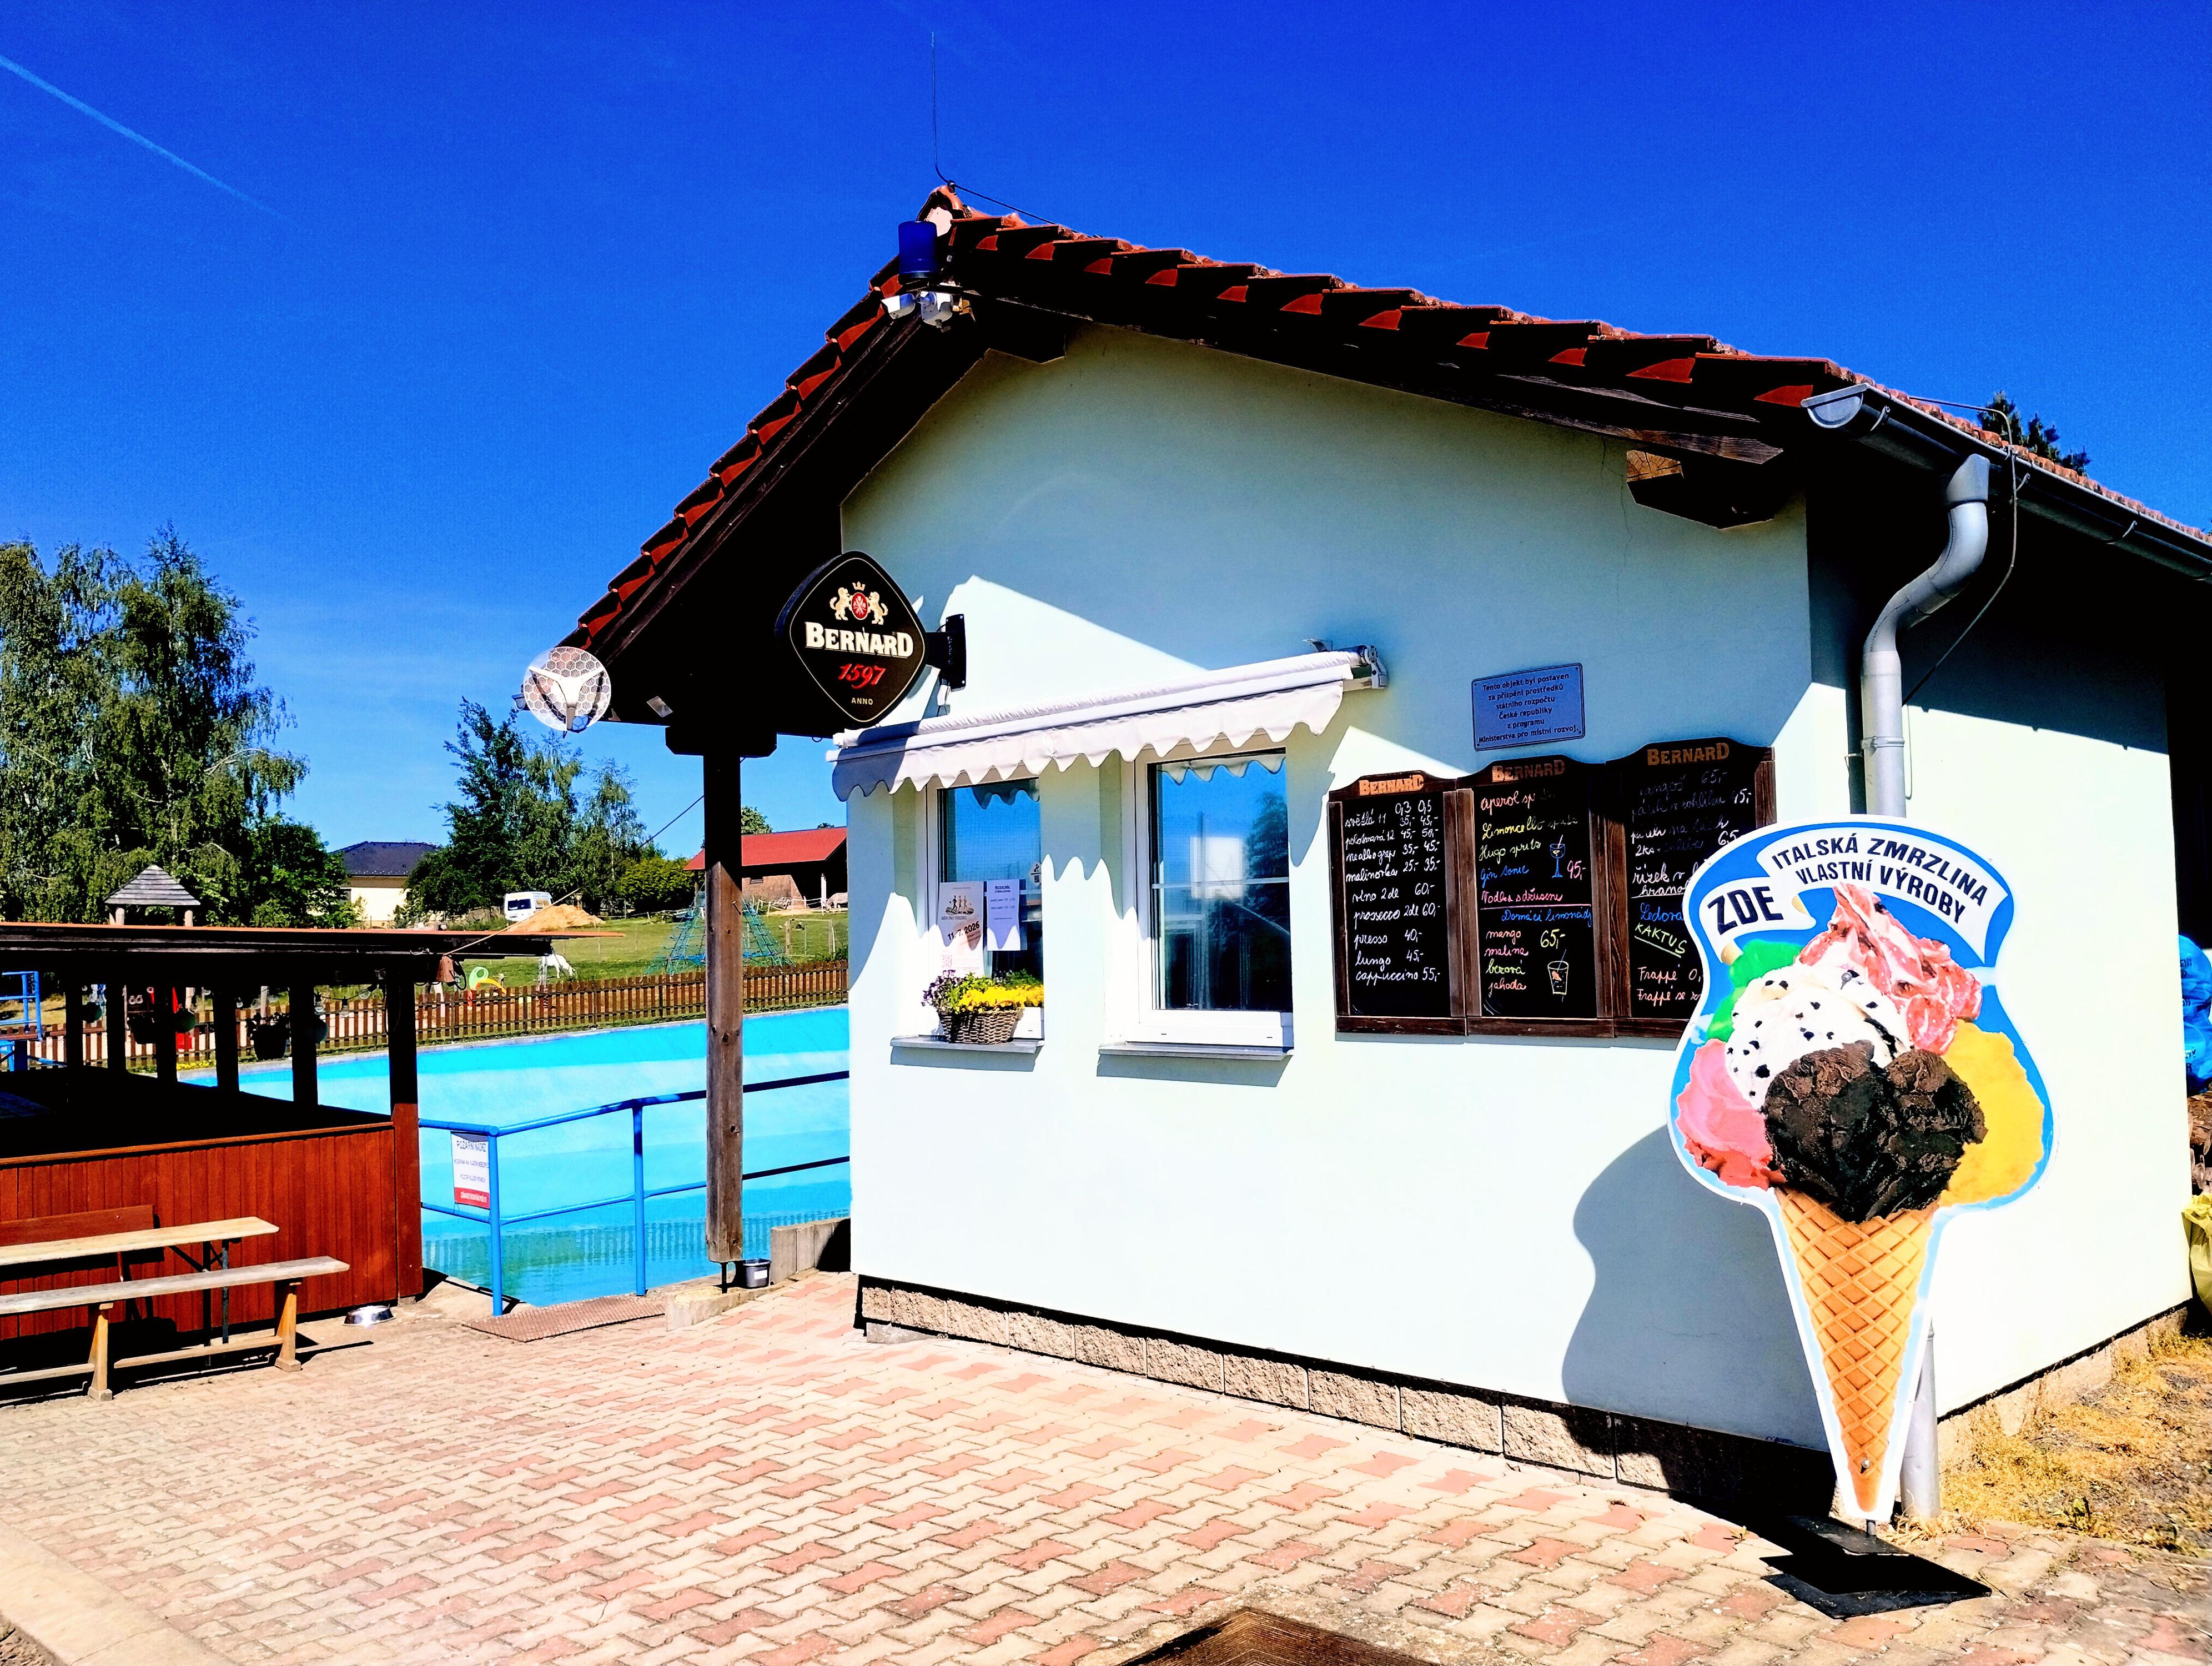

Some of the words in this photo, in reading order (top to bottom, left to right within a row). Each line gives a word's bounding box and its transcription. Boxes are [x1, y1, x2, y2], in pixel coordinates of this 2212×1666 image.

[805, 621, 914, 658] BERNARD
[837, 663, 886, 689] 1597
[1502, 680, 1523, 689] objekt
[1525, 677, 1536, 685] byl
[1537, 673, 1569, 684] postaven
[1525, 683, 1564, 695] prostředků
[851, 697, 873, 705] ANNO
[1496, 701, 1522, 710] státního
[1525, 696, 1555, 706] rozpočtu
[1499, 710, 1518, 720] České
[1520, 706, 1552, 717] republiky
[1479, 734, 1515, 743] Ministerstva
[1554, 724, 1579, 734] rozvoj.
[1512, 719, 1545, 729] programu
[1647, 742, 1730, 766] BERNARD
[1492, 760, 1565, 782] BERNARD
[1359, 774, 1425, 796] BERNARD
[1395, 801, 1412, 816] 0,3
[1417, 800, 1432, 815] 0,5
[1378, 813, 1387, 824] 11
[1386, 829, 1395, 841] 12
[1479, 845, 1506, 865] Hugo
[1771, 832, 1858, 870] ITALSKÁ
[1867, 837, 1989, 907] ZMRZLINA
[1795, 859, 1871, 884] VLASTNÍ
[1880, 864, 1967, 924] VÝROBY
[1353, 909, 1400, 930] prosecco
[1707, 886, 1784, 935] ZDE
[964, 921, 980, 934] 2026
[1354, 934, 1387, 950] presso
[1486, 930, 1521, 945] mango
[1540, 929, 1566, 950] 65,-
[1635, 922, 1687, 954] KAKTUS
[1355, 950, 1391, 971] lungo
[1484, 945, 1529, 957] malina
[1355, 969, 1418, 986] cappuccino
[1637, 964, 1680, 984] Frappé
[1488, 977, 1527, 998] jahoda
